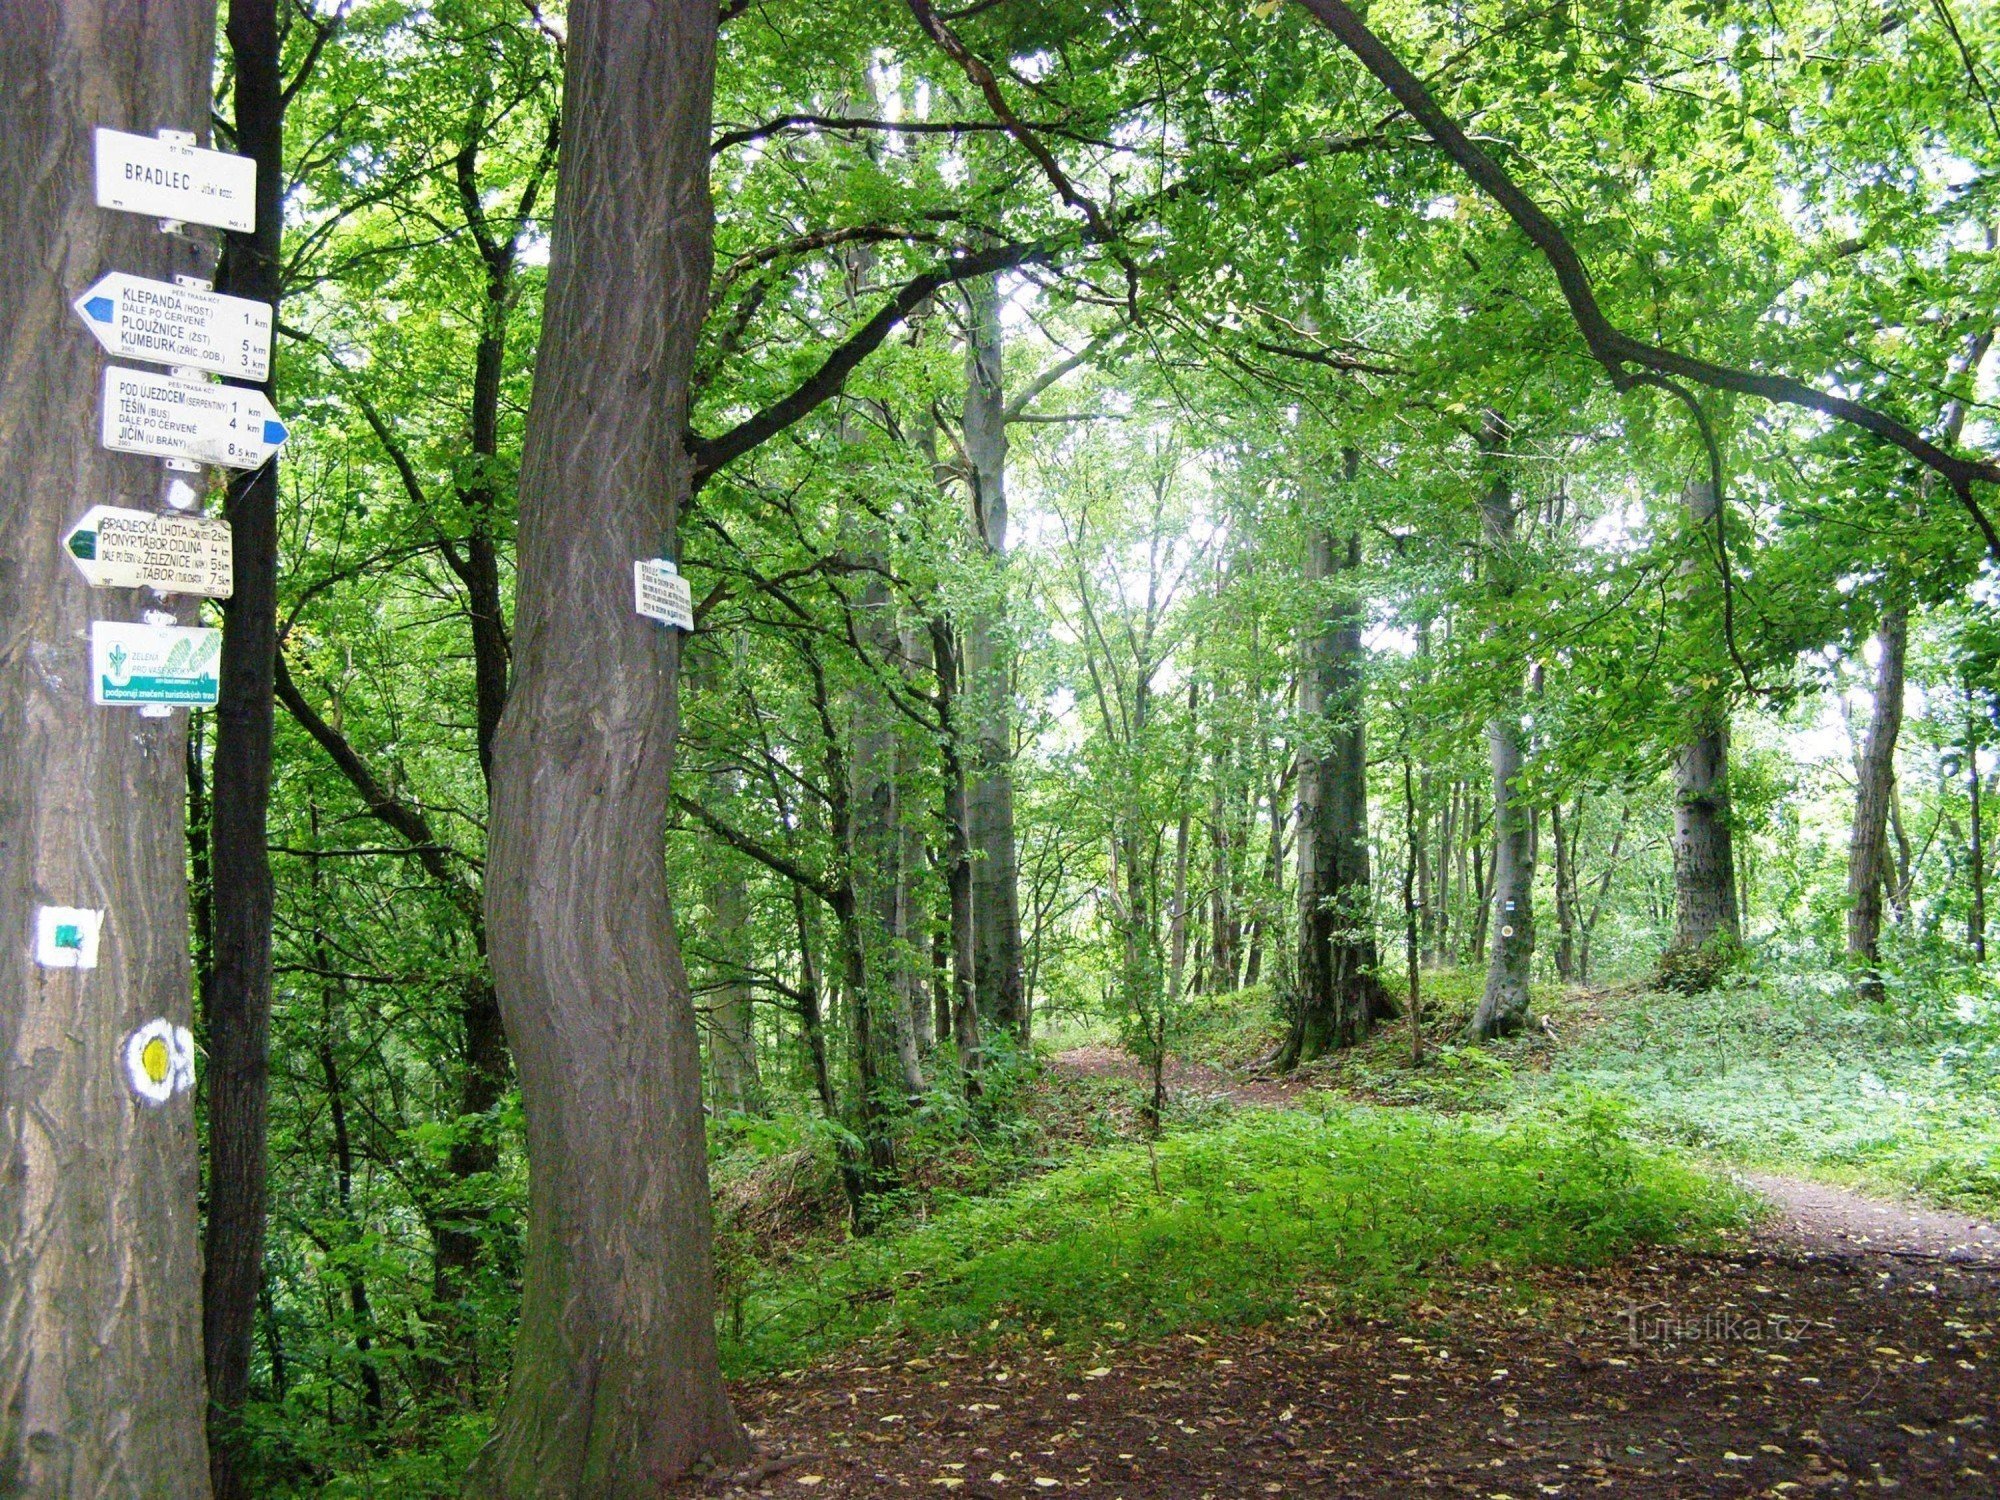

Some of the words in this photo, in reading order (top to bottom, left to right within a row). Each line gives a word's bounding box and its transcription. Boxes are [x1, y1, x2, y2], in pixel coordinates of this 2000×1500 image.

[126, 163, 190, 191] BRADLEC
[123, 287, 182, 311] KLEPANDA
[150, 309, 162, 319] PO
[243, 313, 249, 325] 1
[255, 319, 269, 329] km
[122, 315, 185, 339] PLOUŽNICE
[243, 339, 250, 352] 5
[254, 346, 267, 355] km
[122, 331, 176, 353] KUMBURK
[242, 354, 249, 366] 3
[253, 361, 267, 370] km
[182, 384, 202, 392] TRASA
[120, 382, 138, 397] POD
[141, 382, 186, 404] ÚJEZDCEM
[231, 401, 238, 413] 1
[249, 408, 262, 417] km
[121, 397, 146, 415] TĚŠÍN
[149, 408, 171, 421] (BUS)
[230, 417, 237, 430] 4
[247, 425, 260, 433] km
[144, 419, 156, 428] PO
[119, 425, 145, 442] JIČÍN
[146, 434, 154, 445] (U
[246, 450, 259, 459] km
[103, 516, 158, 535] BRADLECKÁ
[161, 523, 188, 538] LHOTA
[211, 544, 218, 555] 4
[143, 564, 174, 582] TÁBOR
[132, 665, 146, 674] PRO
